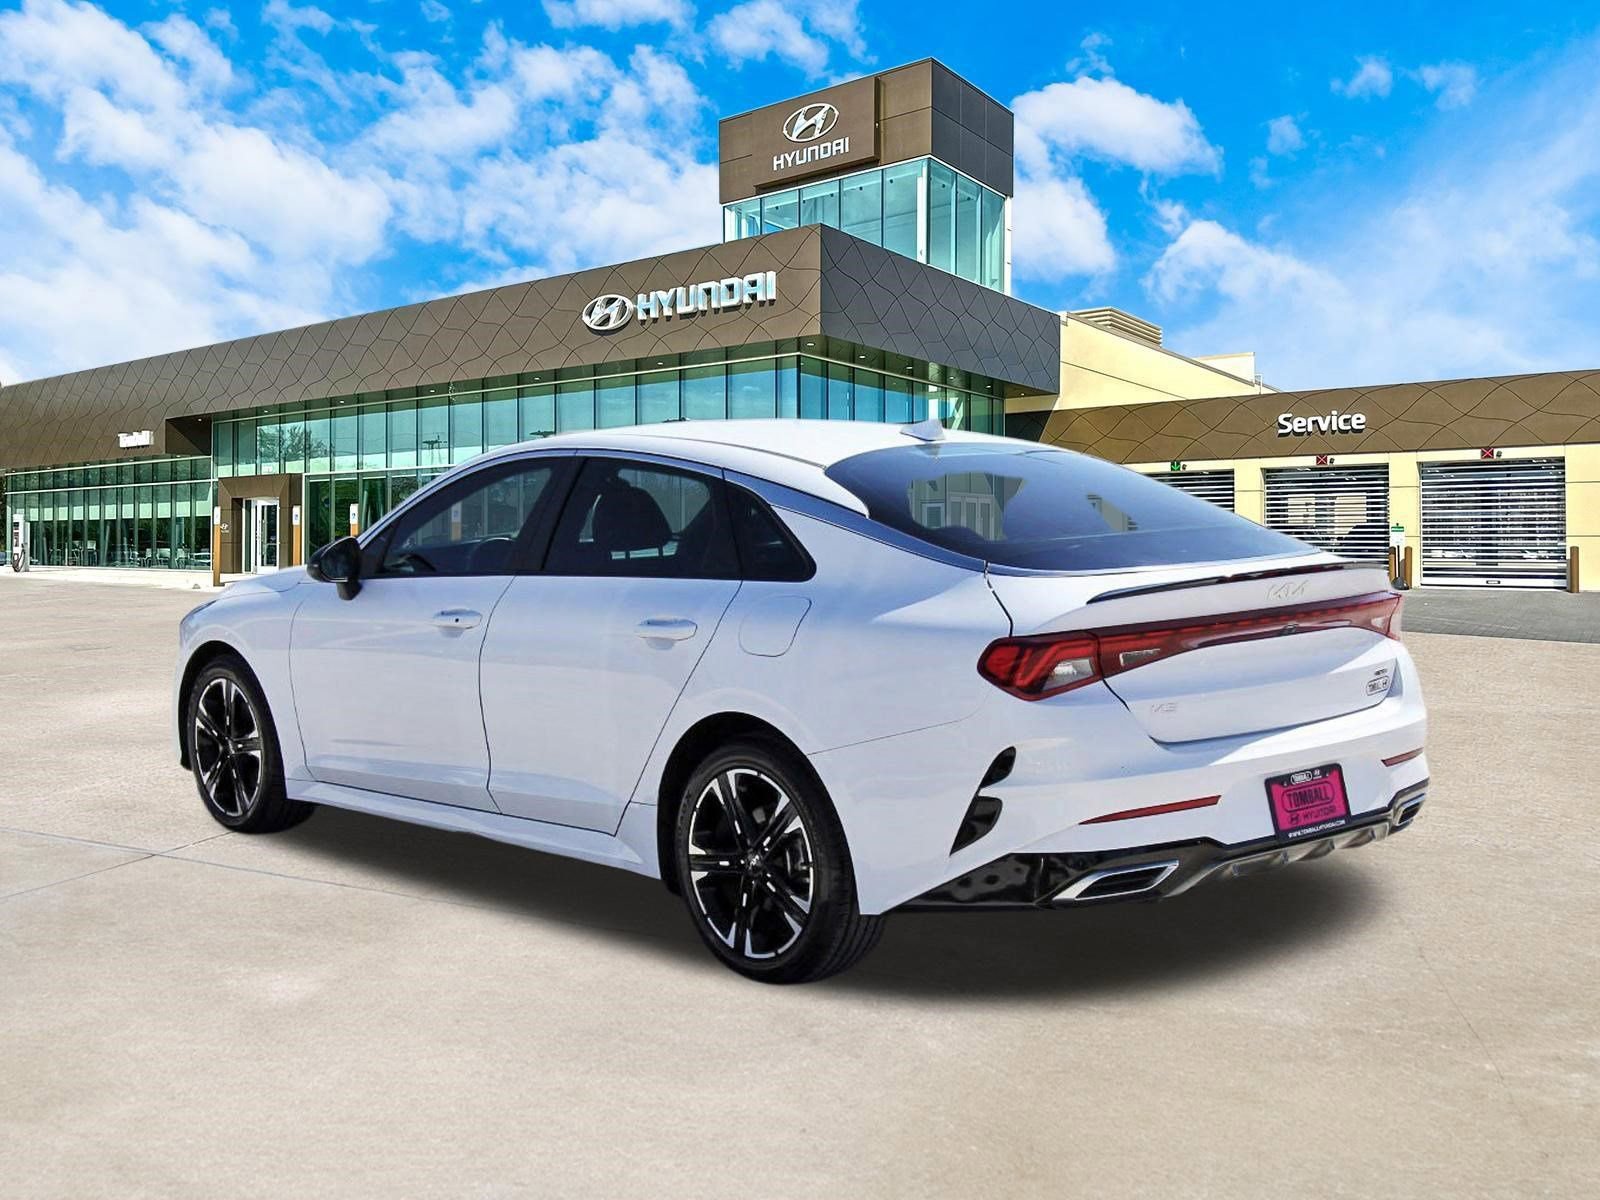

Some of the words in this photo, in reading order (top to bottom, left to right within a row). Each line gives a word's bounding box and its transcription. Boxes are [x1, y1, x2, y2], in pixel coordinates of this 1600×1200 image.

[773, 136, 849, 171] HYUNDAI
[636, 271, 777, 321] HYUNDAI
[1278, 410, 1366, 434] Service
[1286, 786, 1330, 808] TOMBALL
